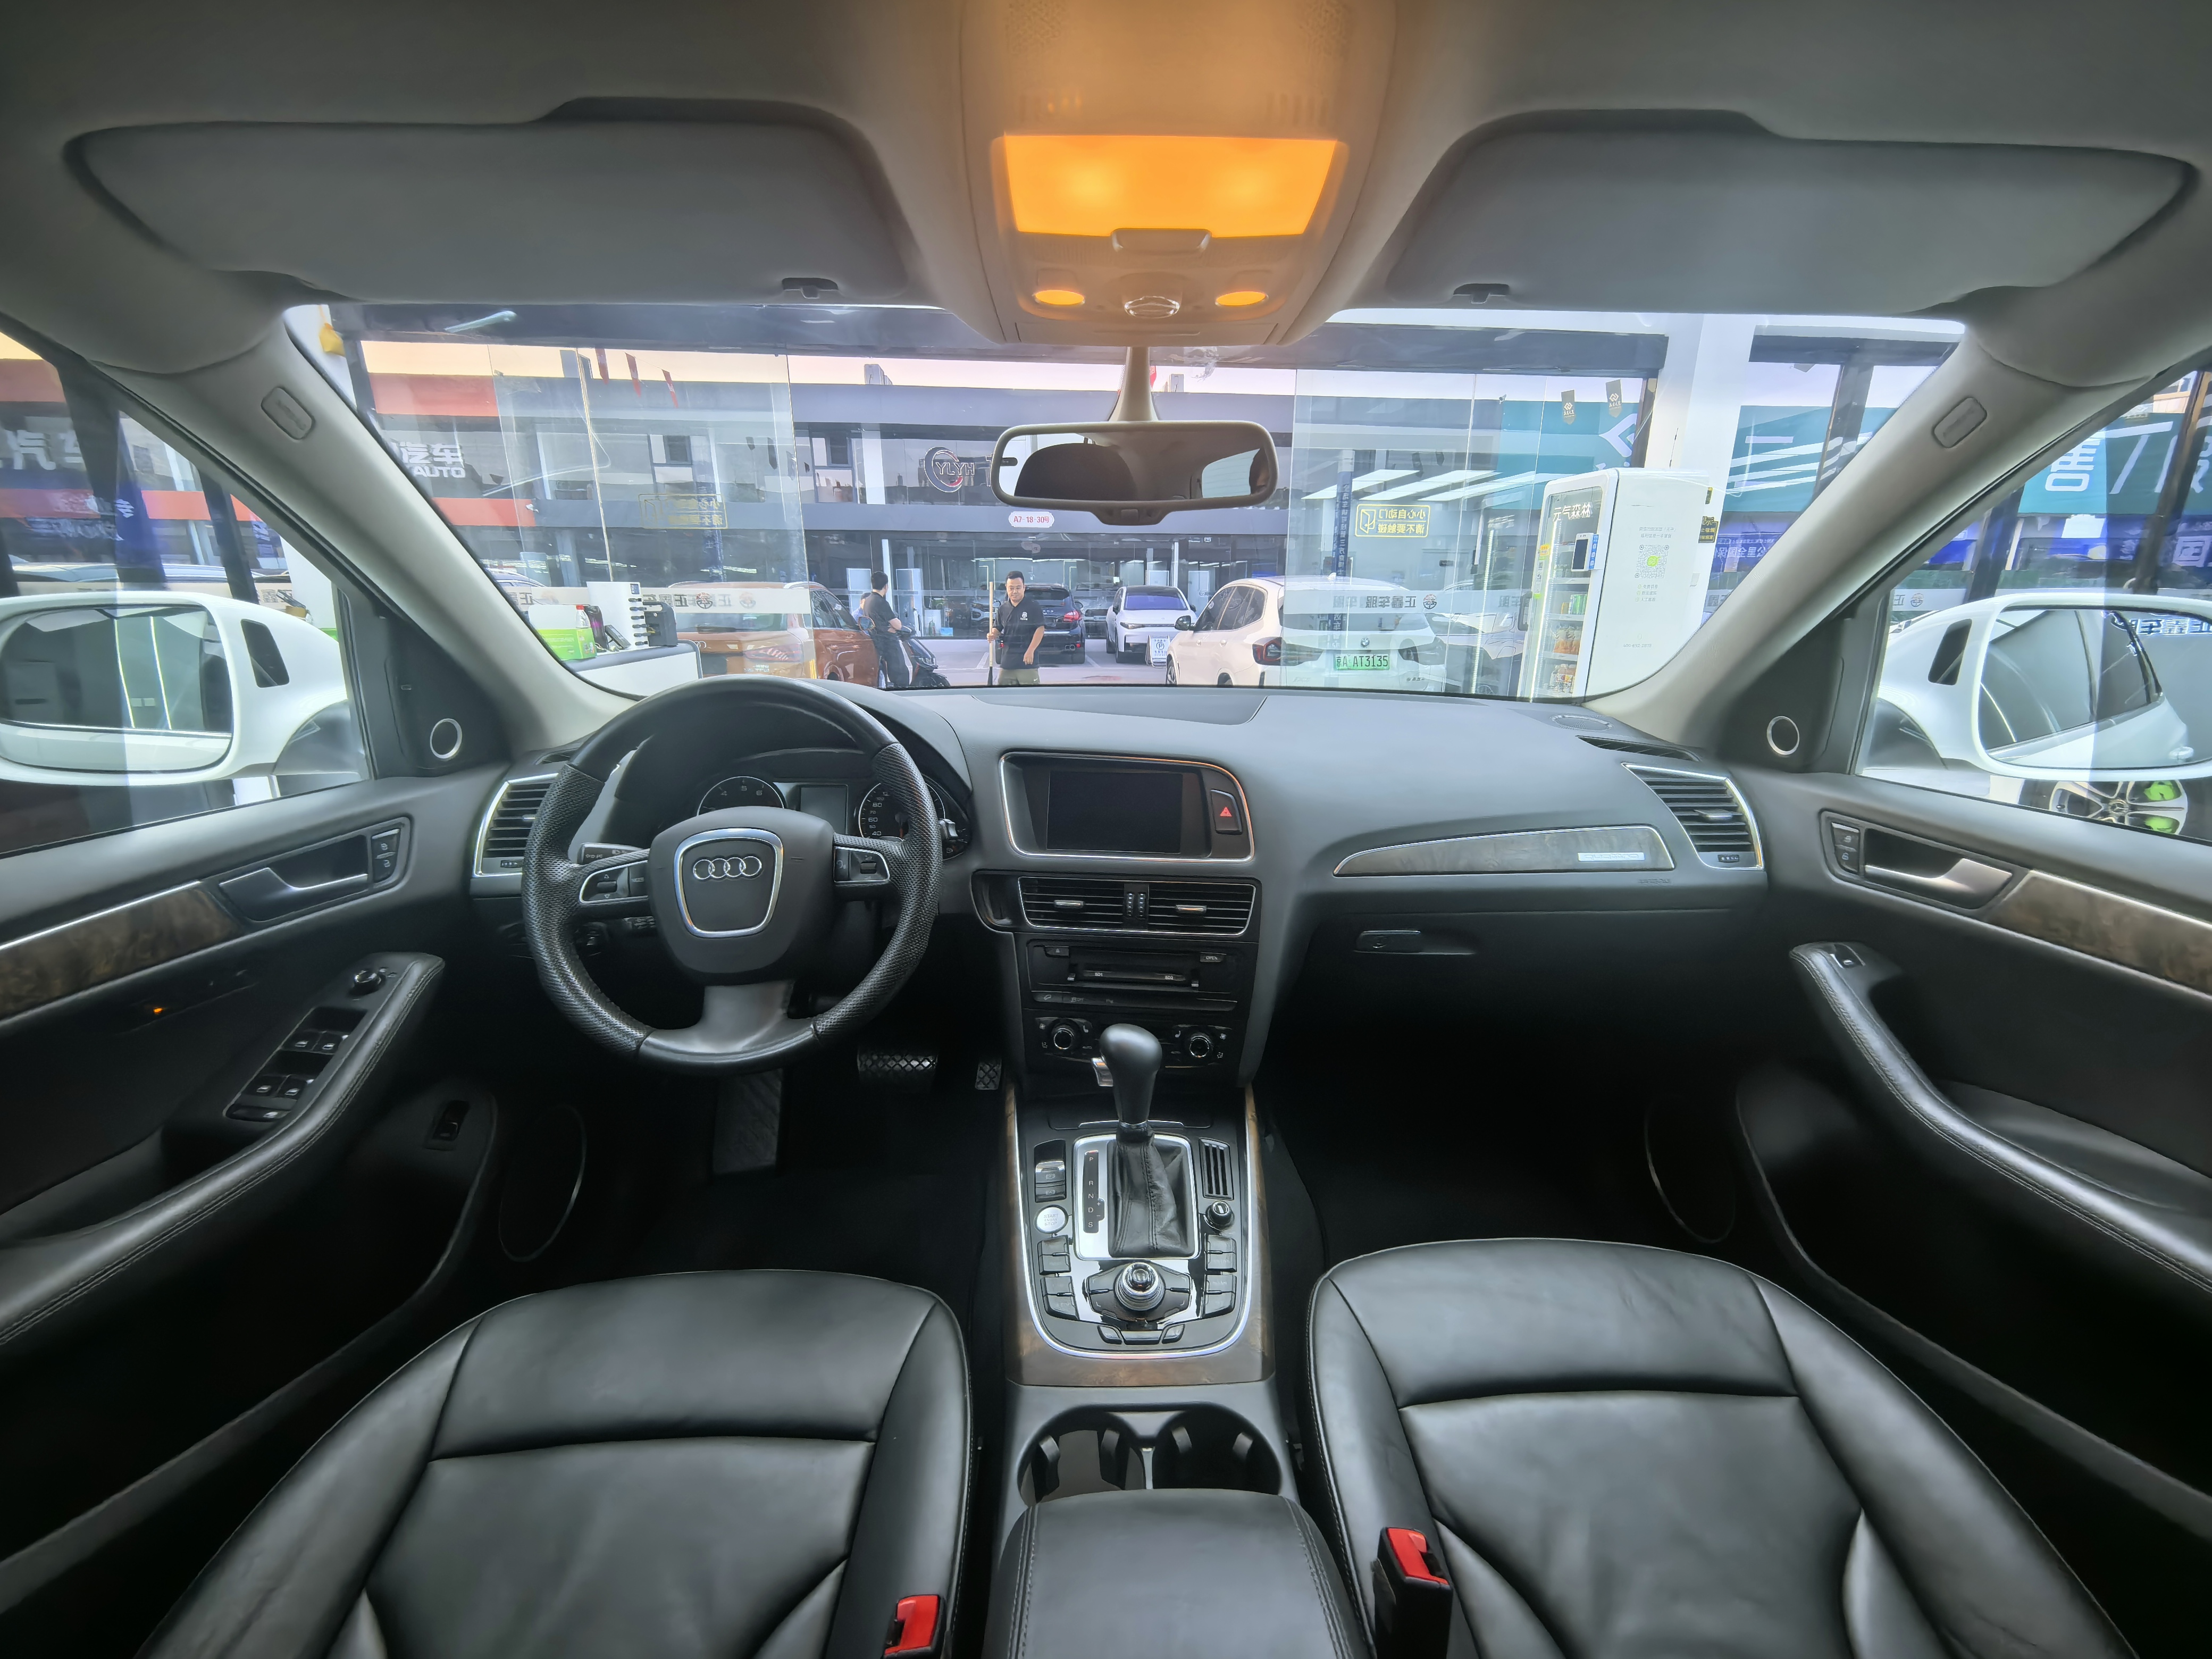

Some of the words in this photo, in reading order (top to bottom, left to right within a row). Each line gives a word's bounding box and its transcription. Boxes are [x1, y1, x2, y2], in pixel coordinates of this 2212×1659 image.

[413, 466, 466, 478] AUTO
[935, 462, 975, 476] YLYH
[1553, 502, 1591, 522] 元气森林
[1353, 656, 1389, 668] AT3135
